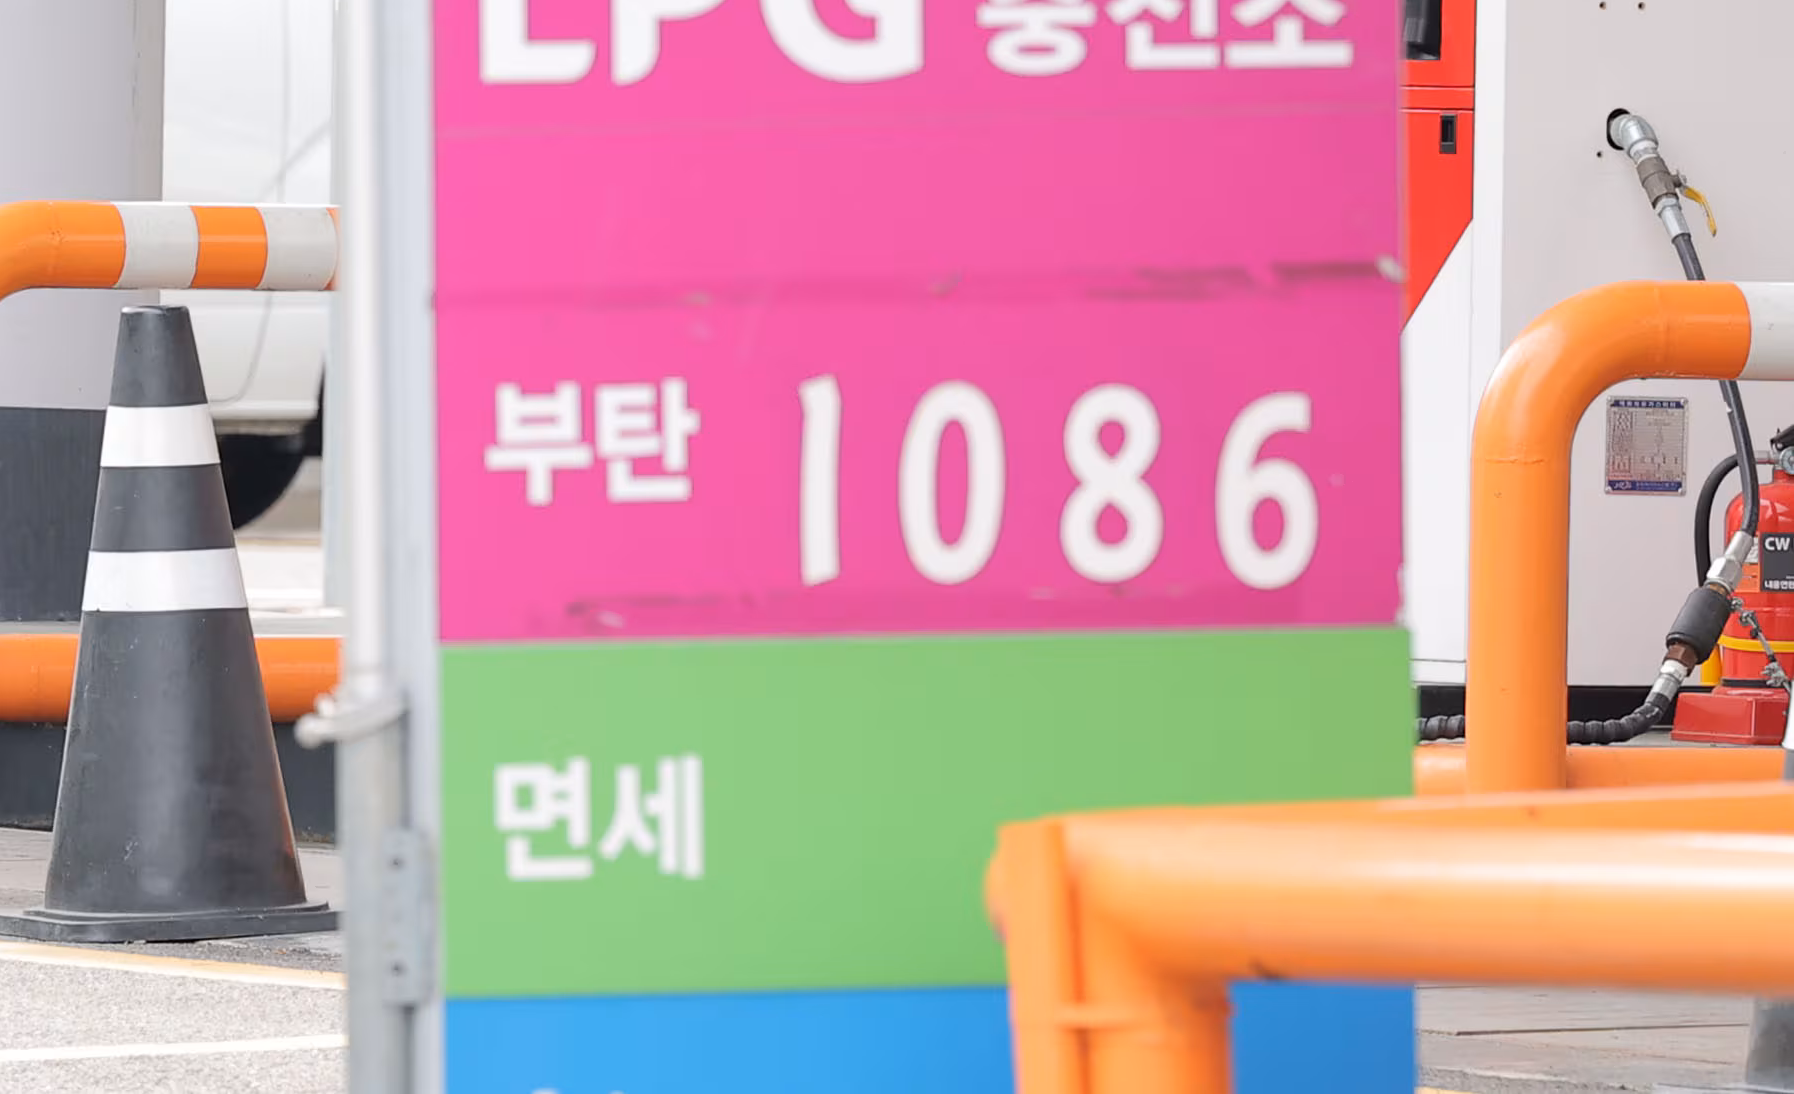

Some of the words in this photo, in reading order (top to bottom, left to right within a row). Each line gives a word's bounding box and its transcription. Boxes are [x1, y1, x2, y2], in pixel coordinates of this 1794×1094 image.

[483, 377, 701, 506] 부탄
[798, 374, 1319, 590] 1086
[493, 753, 705, 882] 면세
